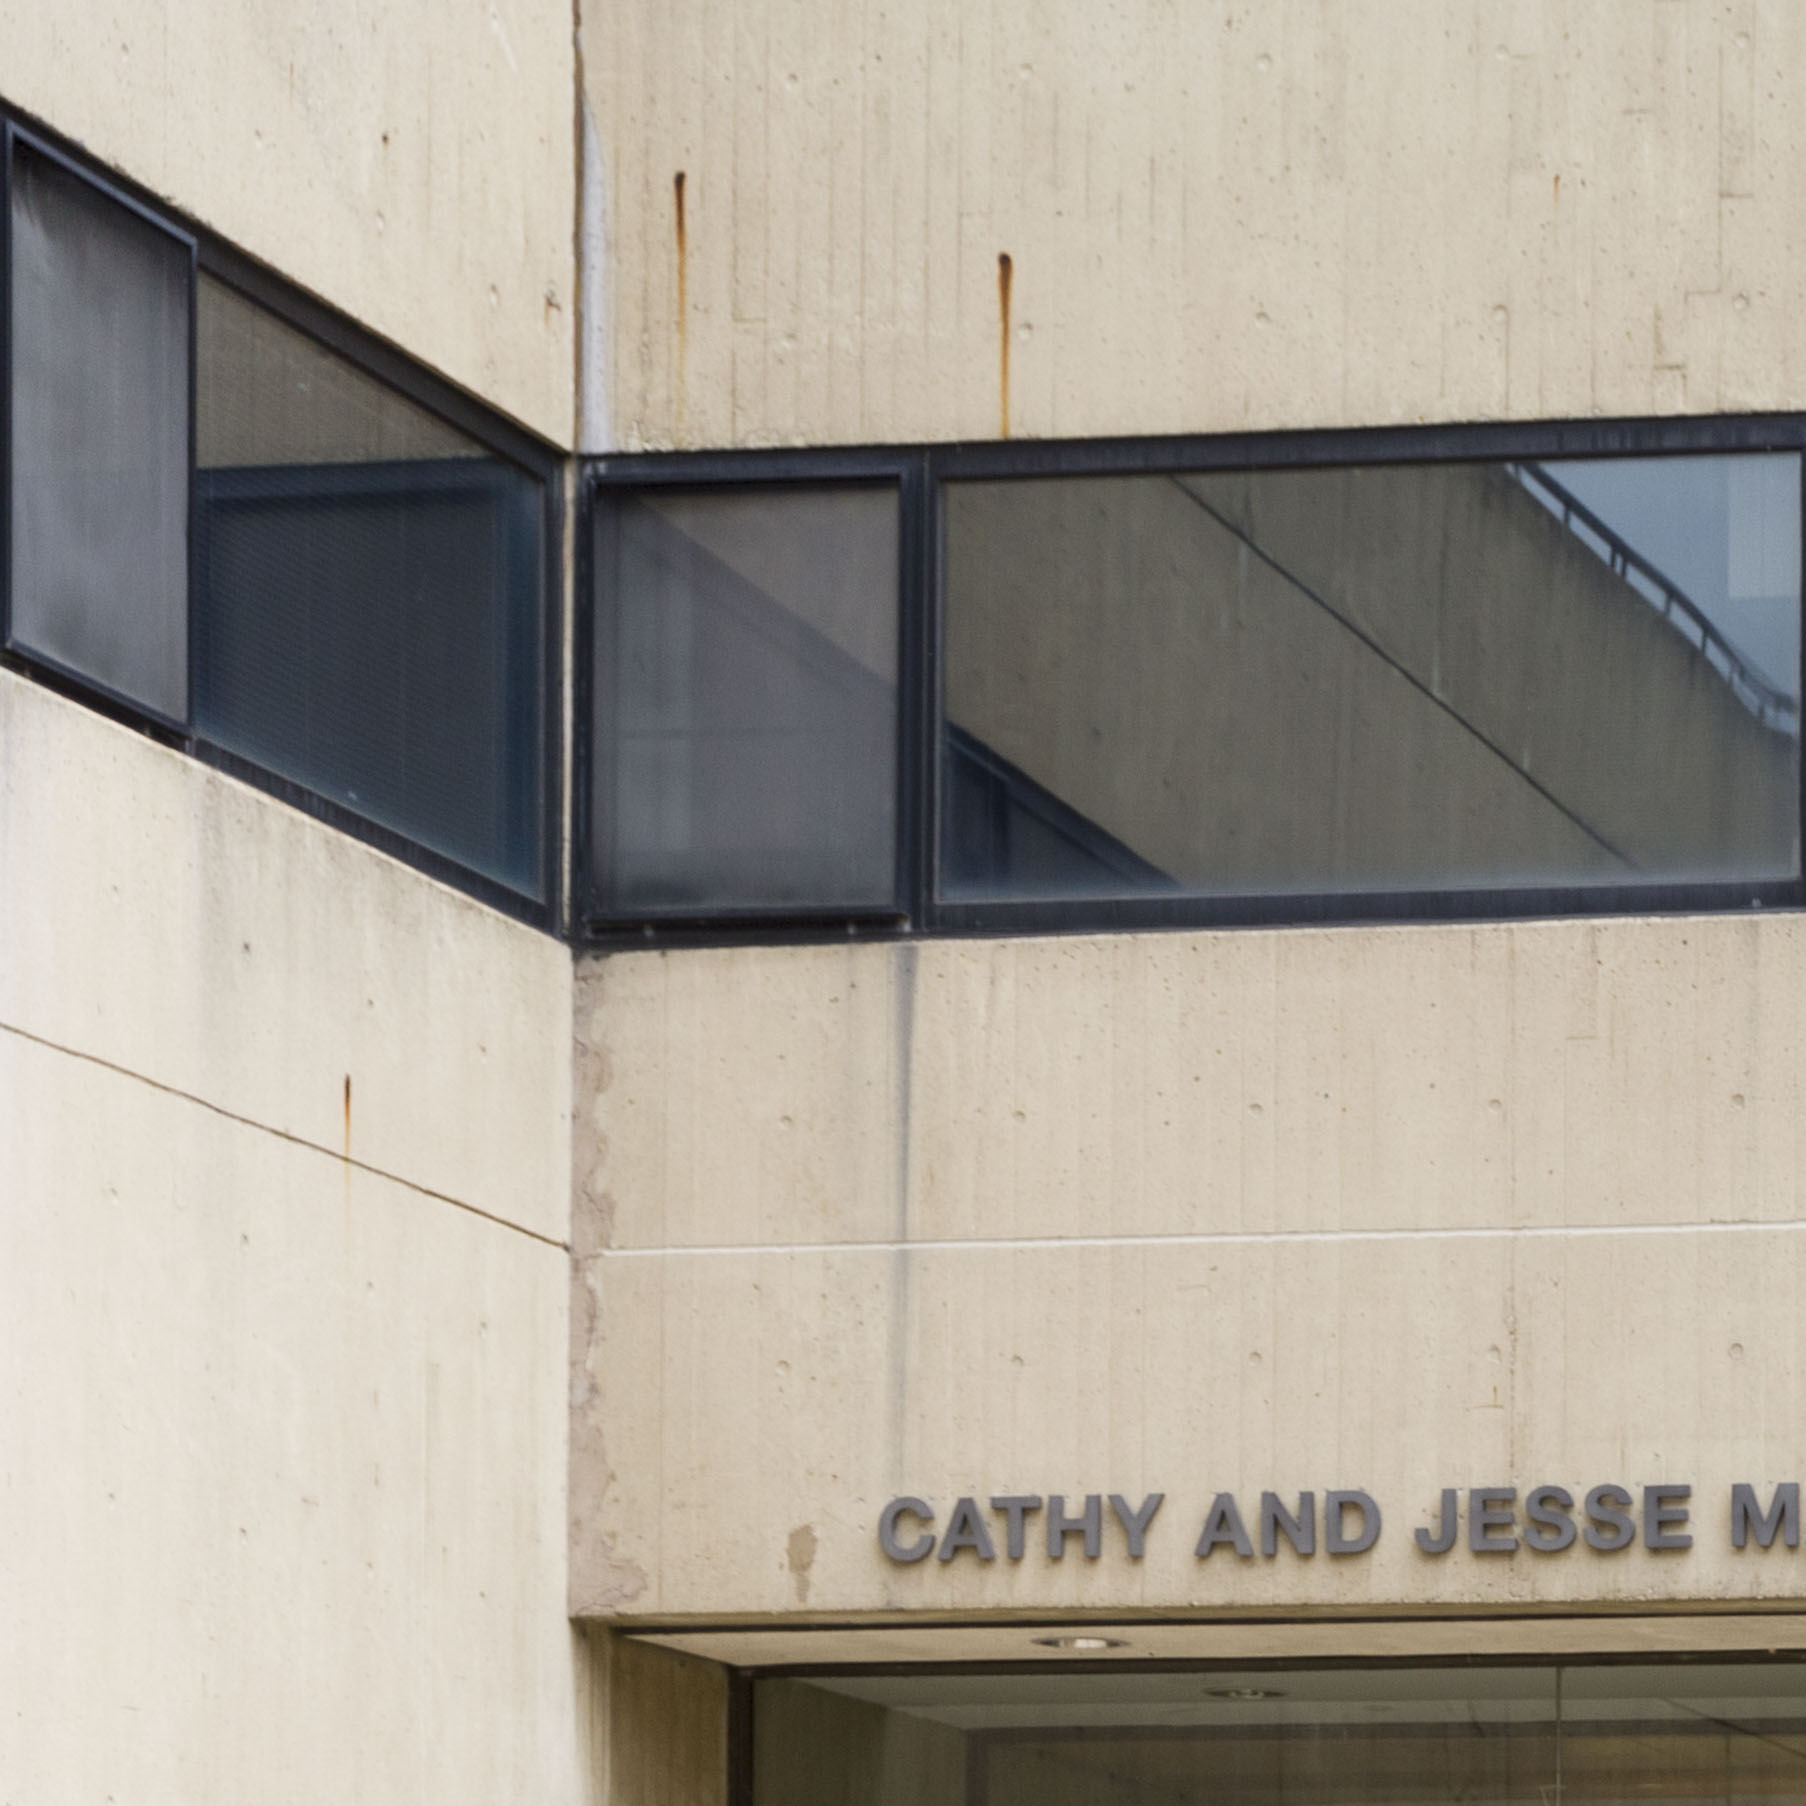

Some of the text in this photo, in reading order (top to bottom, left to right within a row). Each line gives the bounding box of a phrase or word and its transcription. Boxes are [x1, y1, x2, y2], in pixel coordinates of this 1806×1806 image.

[877, 1492, 1165, 1564] CATHY
[1194, 1490, 1383, 1557] AND
[1414, 1484, 1693, 1553] JESSE
